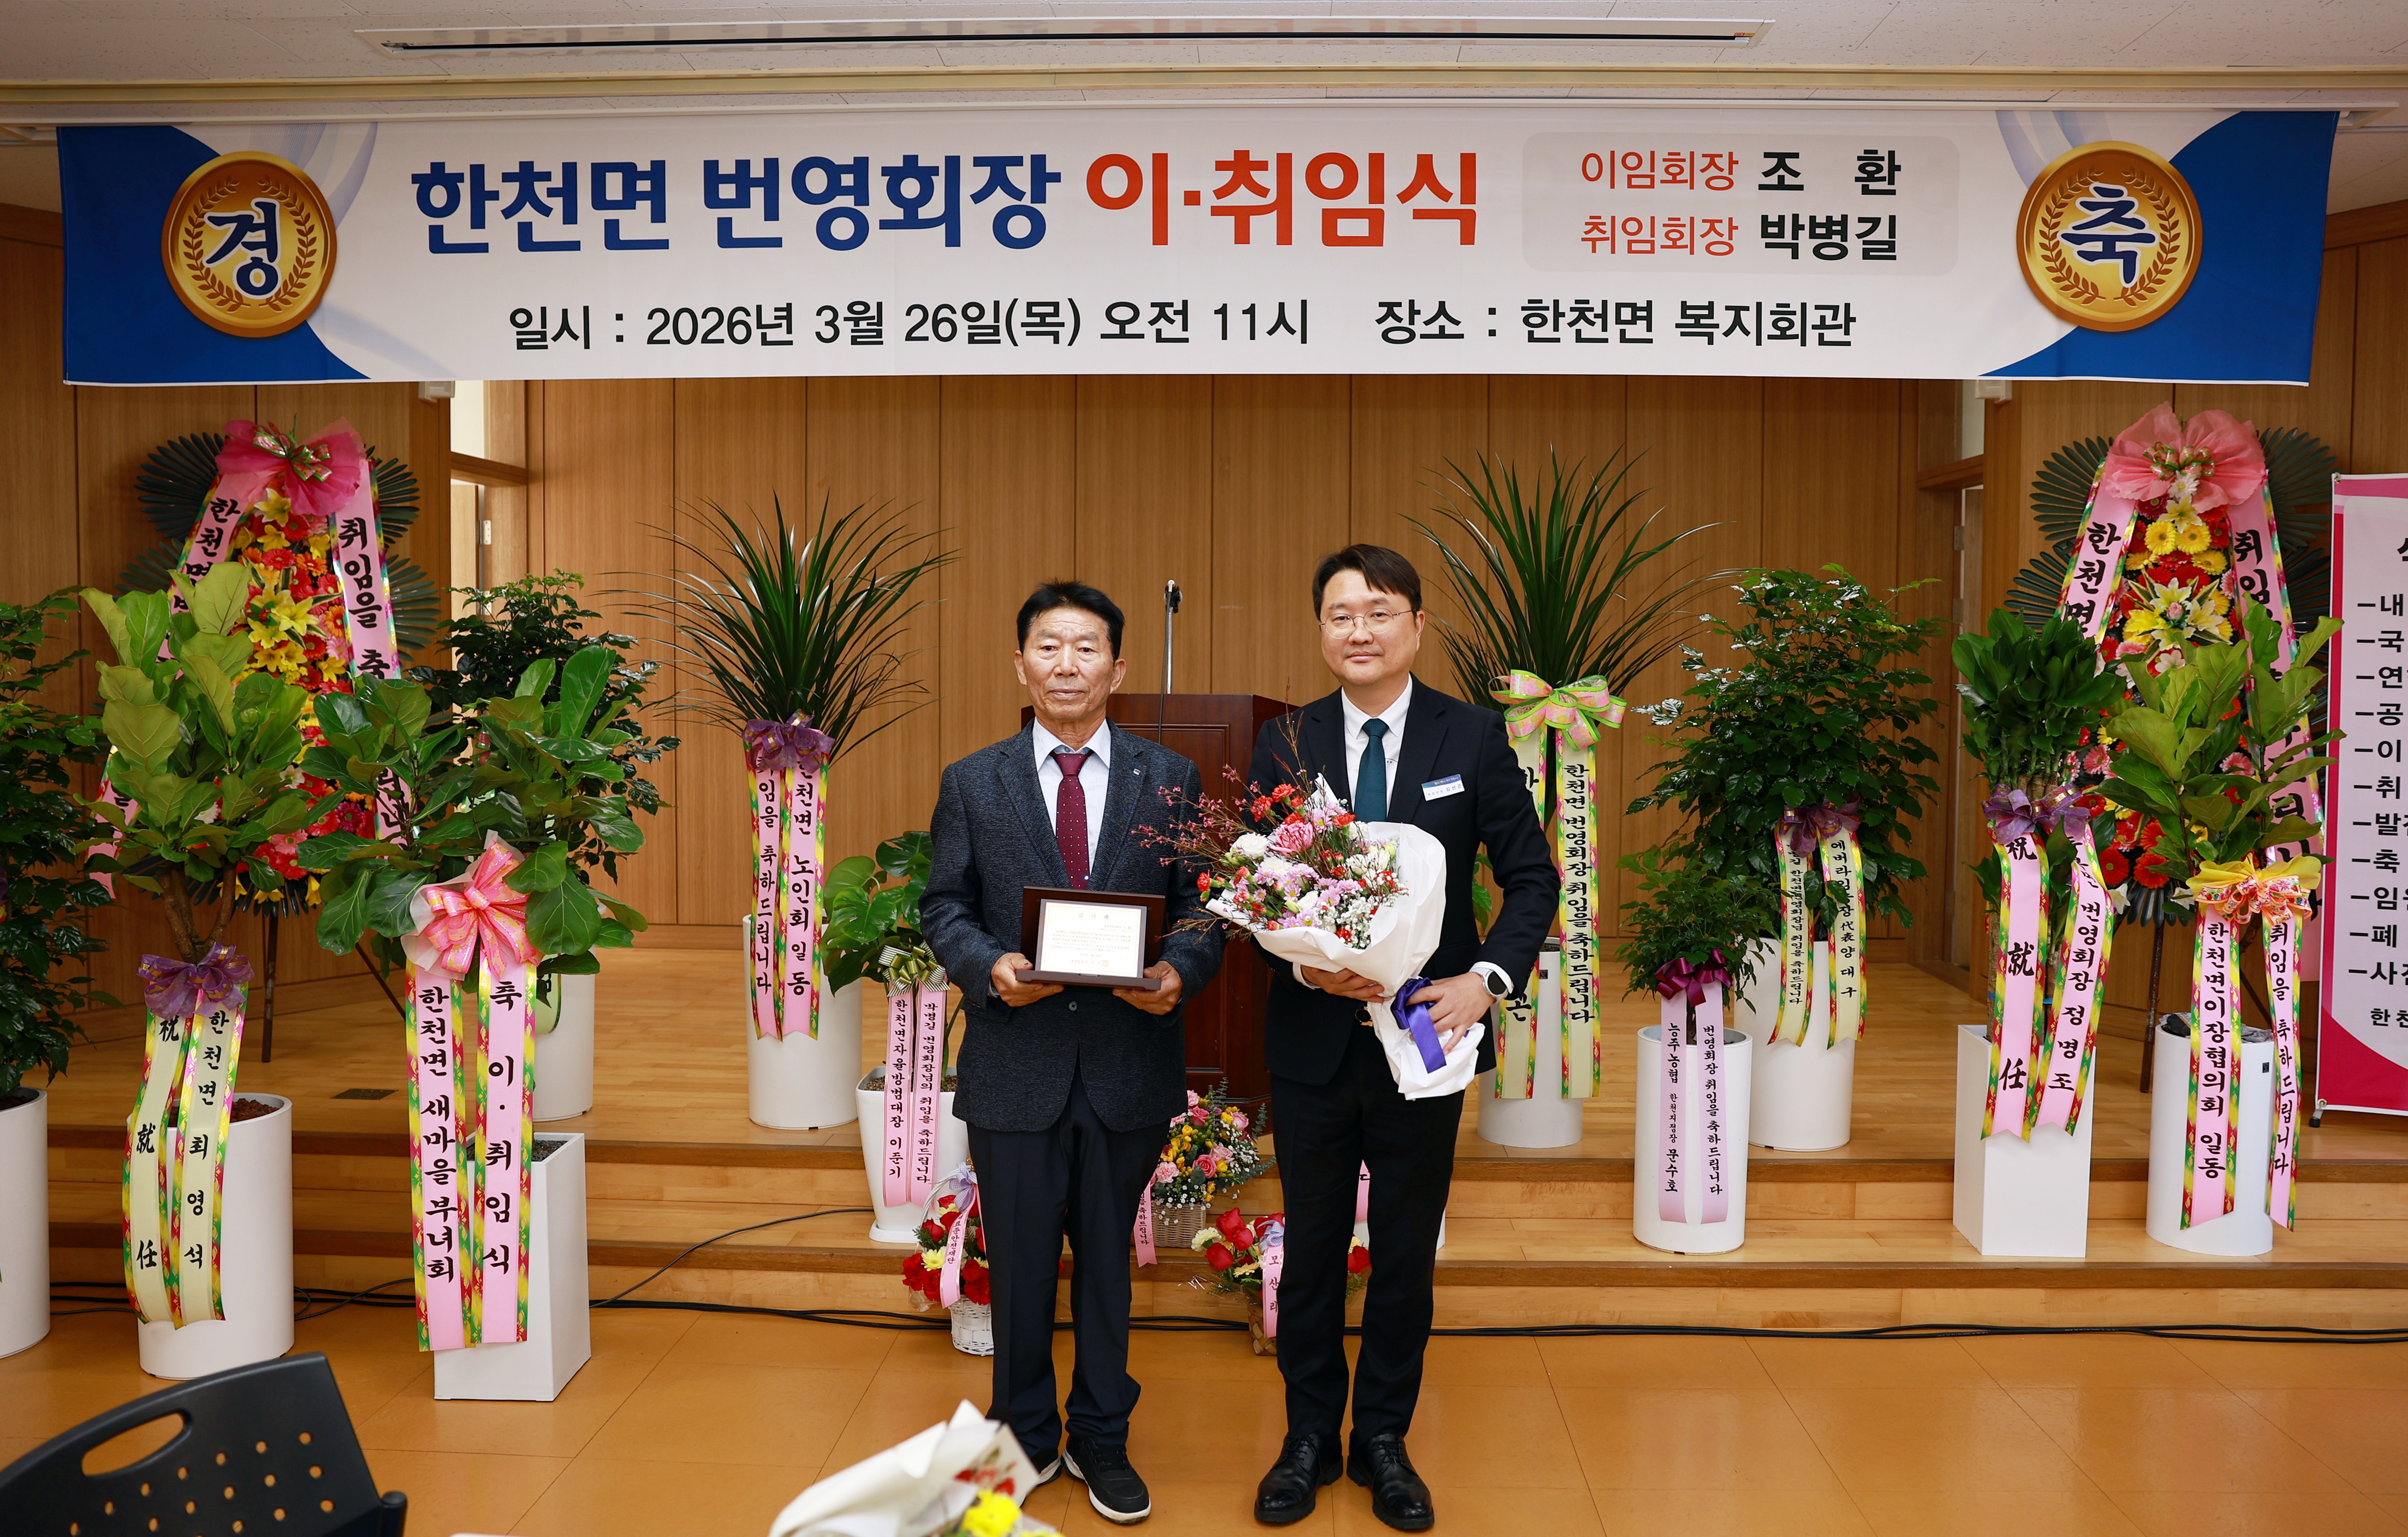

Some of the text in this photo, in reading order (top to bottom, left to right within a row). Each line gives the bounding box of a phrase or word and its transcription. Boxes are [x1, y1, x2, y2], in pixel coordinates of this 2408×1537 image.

[411, 146, 1477, 254] 한천면 번영회장 이·취임식
[1581, 149, 1738, 191] 이임회장
[205, 199, 283, 301] 경
[1581, 211, 1899, 262] 취임회장 박병길
[2059, 181, 2156, 283] 축
[509, 306, 591, 350] 일시
[646, 301, 793, 348] 2026년
[815, 302, 884, 347] 3월
[903, 301, 1082, 346] 26일(목)
[1101, 301, 1190, 345] 오전
[1213, 300, 1309, 344] 11시
[1374, 298, 1462, 343] 장소
[1520, 299, 1655, 346] 한천면
[1674, 298, 1856, 347] 복지회관
[338, 517, 382, 628] 취임을
[755, 845, 777, 995] 축하드립니다
[790, 855, 814, 932] 노인회
[1564, 764, 1596, 1025] 한천면 번영회장 취임을 축하드립니다
[1840, 921, 1855, 943] 代表
[787, 941, 811, 996] 일동
[1789, 960, 1804, 1005] 축하드립니다
[1790, 934, 1804, 957] 취임을
[2067, 902, 2100, 992] 번영회장
[490, 980, 522, 1013] 축
[198, 1011, 230, 1106] 한천면
[916, 1003, 938, 1184] 박병길 번영회장님의 취임을 축하드립니다
[2197, 922, 2230, 1179] 한천면이장협의회 일동
[2270, 923, 2296, 1177] 취임을 축하드립니다
[418, 986, 458, 1283] 한천면 새마을 부녀회
[1665, 1023, 1681, 1193] 능주농협 한천지점장 문수호
[1703, 1025, 1723, 1196] 번영회장 취임을 축하드립니다
[889, 1137, 904, 1180] 이준기
[1138, 1207, 1149, 1245] 축하드립니다
